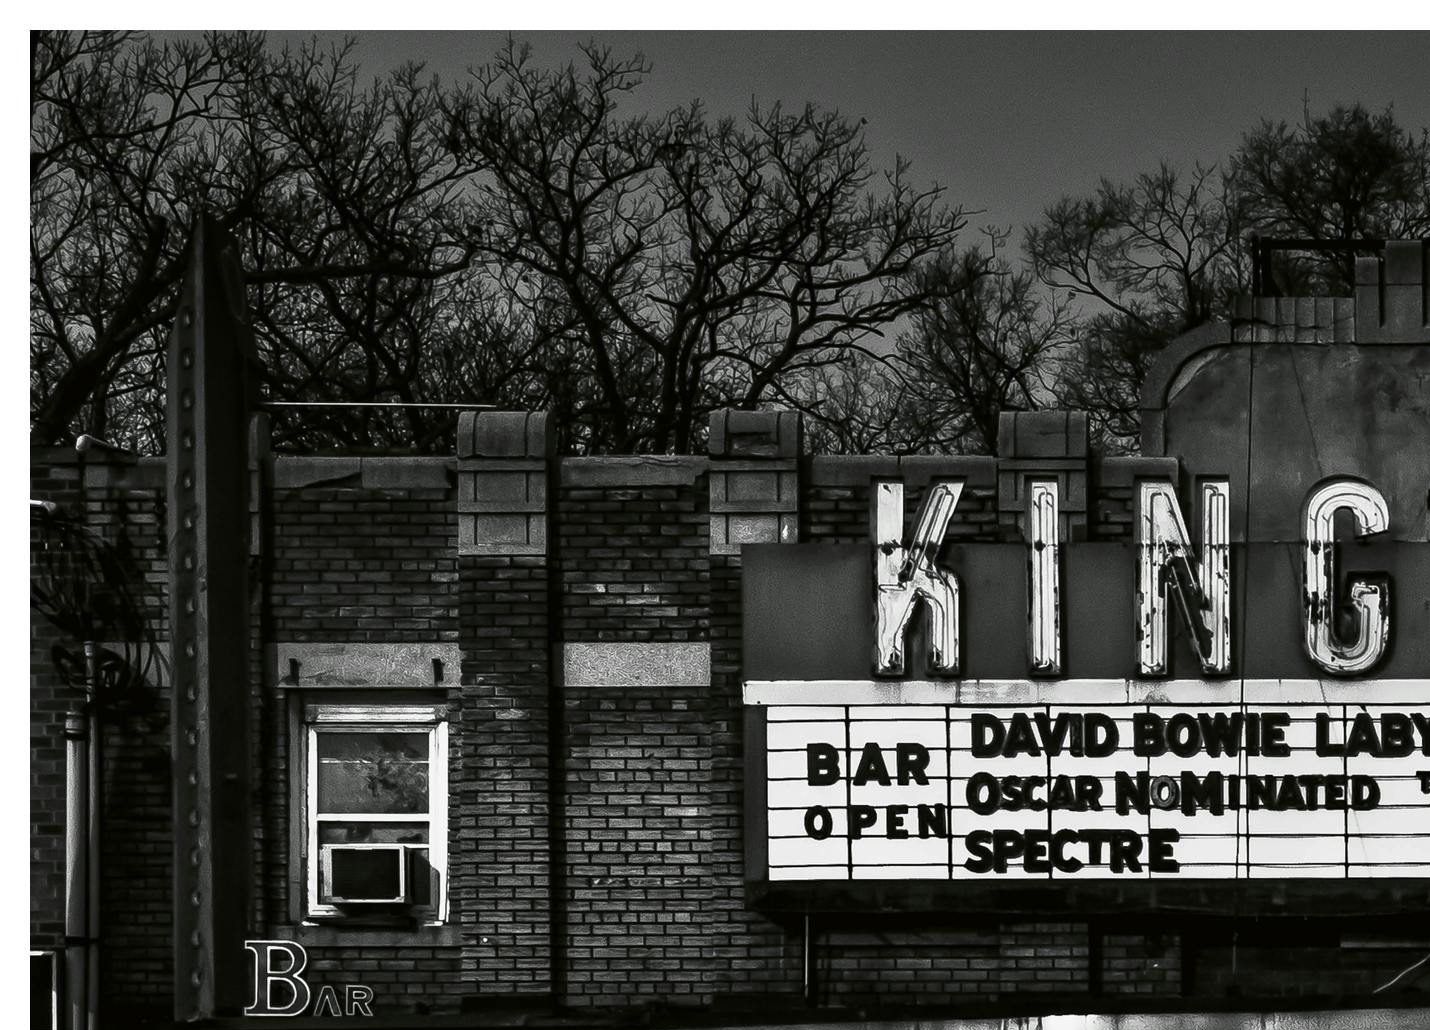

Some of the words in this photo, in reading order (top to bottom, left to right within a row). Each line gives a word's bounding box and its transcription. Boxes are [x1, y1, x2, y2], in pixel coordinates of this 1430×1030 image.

[971, 712, 1120, 758] DAVID
[1133, 712, 1290, 758] BOWIE
[806, 742, 930, 787] BAR
[965, 771, 1103, 815] OSCAR
[1116, 770, 1381, 816] NOMINATED
[803, 803, 947, 841] OPEN
[964, 828, 1179, 873] SPECTRE
